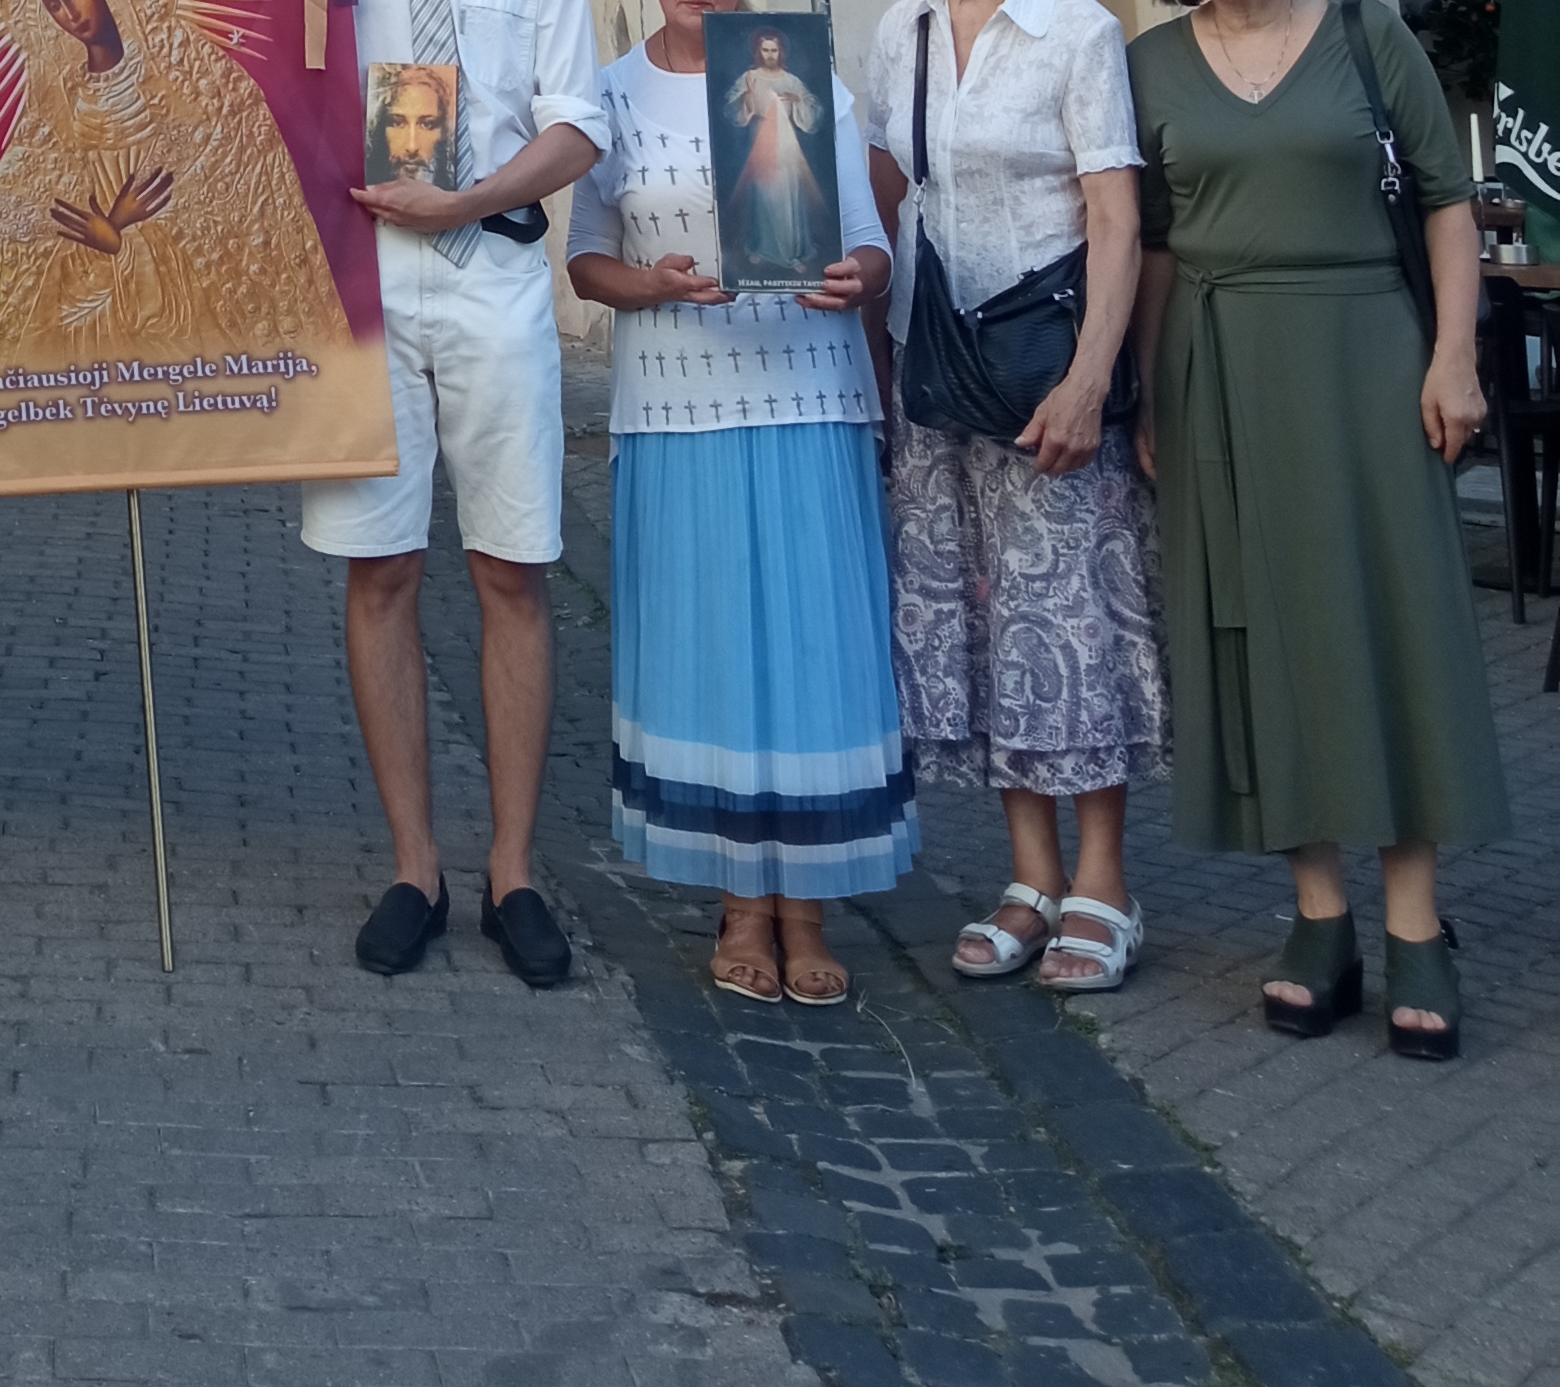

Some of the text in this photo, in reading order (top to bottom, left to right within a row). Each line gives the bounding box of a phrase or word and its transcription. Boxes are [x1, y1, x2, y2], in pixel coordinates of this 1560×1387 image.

[1495, 107, 1560, 178] rlsbe
[116, 357, 218, 386] Mergele
[224, 351, 319, 379] Marija,
[79, 396, 170, 423] Tėvynę
[176, 386, 278, 415] Lietuvą!
